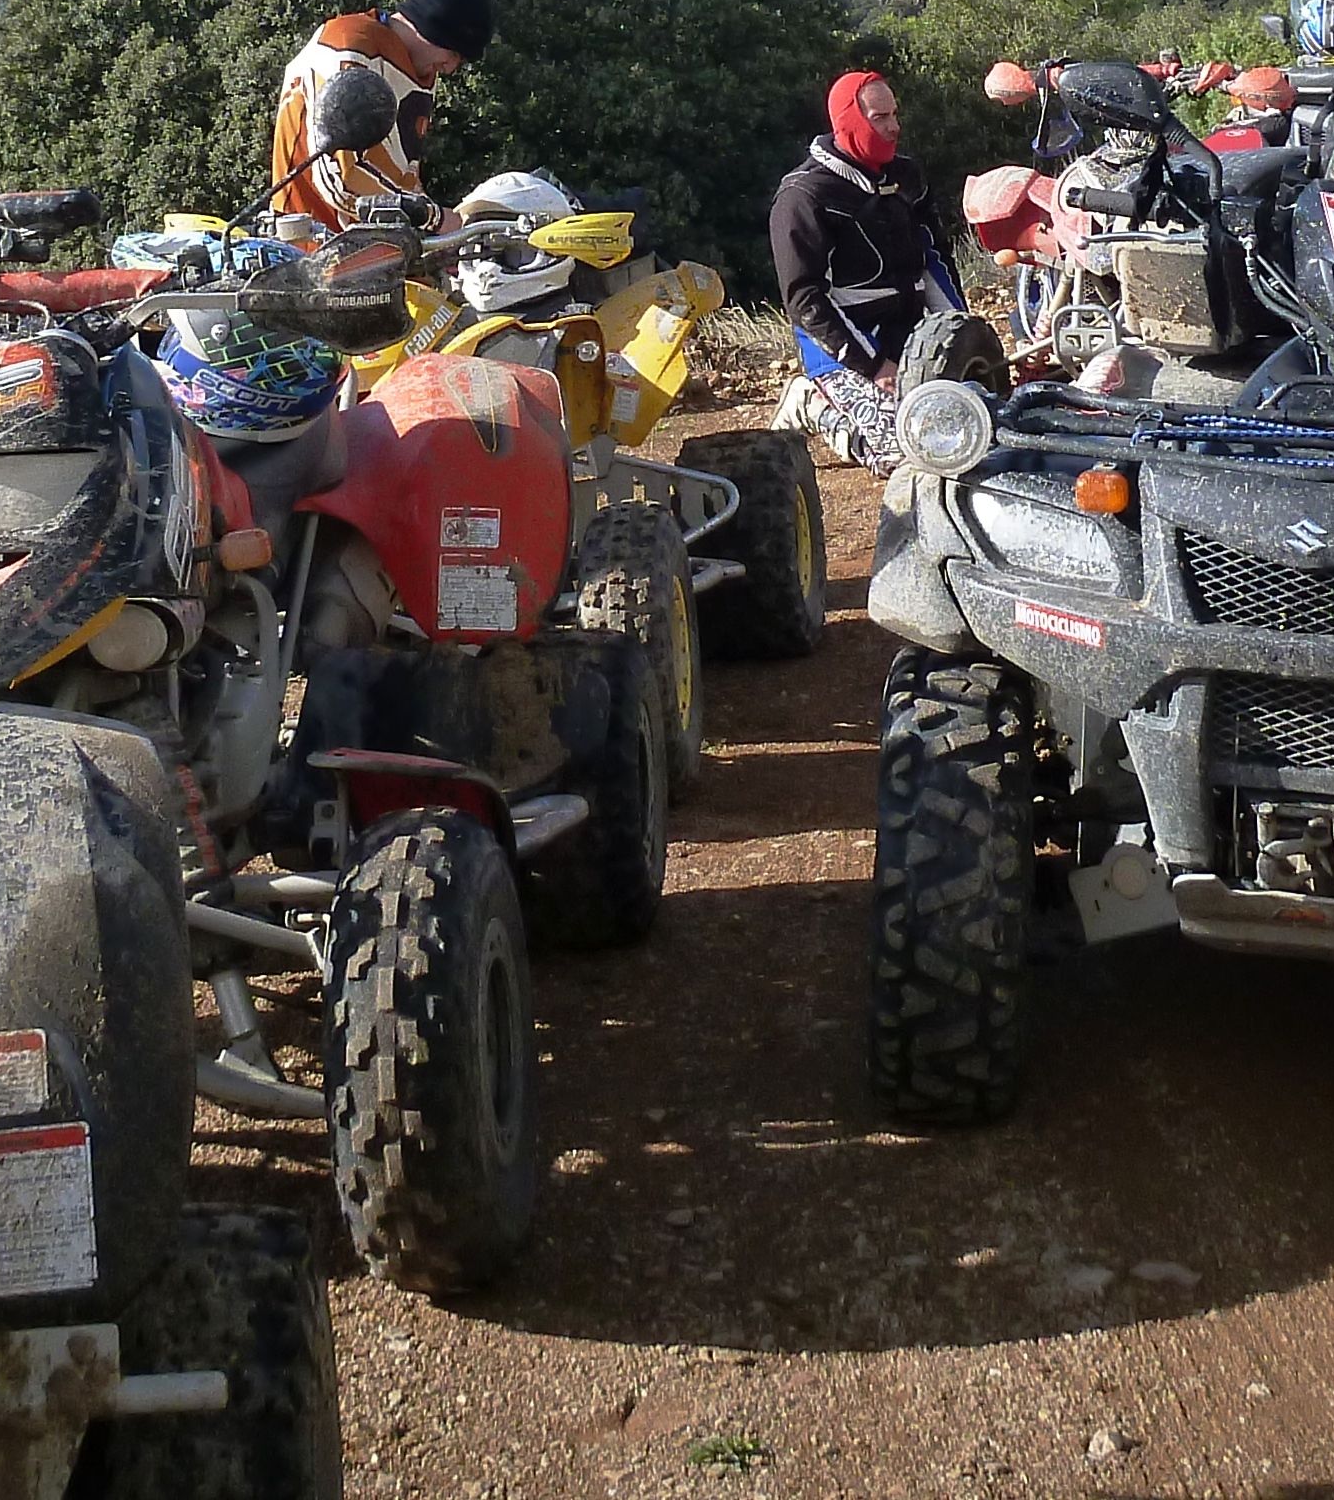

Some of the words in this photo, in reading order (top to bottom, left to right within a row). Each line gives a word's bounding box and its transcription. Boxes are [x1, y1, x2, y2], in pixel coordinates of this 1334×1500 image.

[326, 293, 391, 307] BOMBARDIER
[191, 368, 301, 412] SCOTT
[1014, 601, 1102, 645] MOTOCICLISMO
